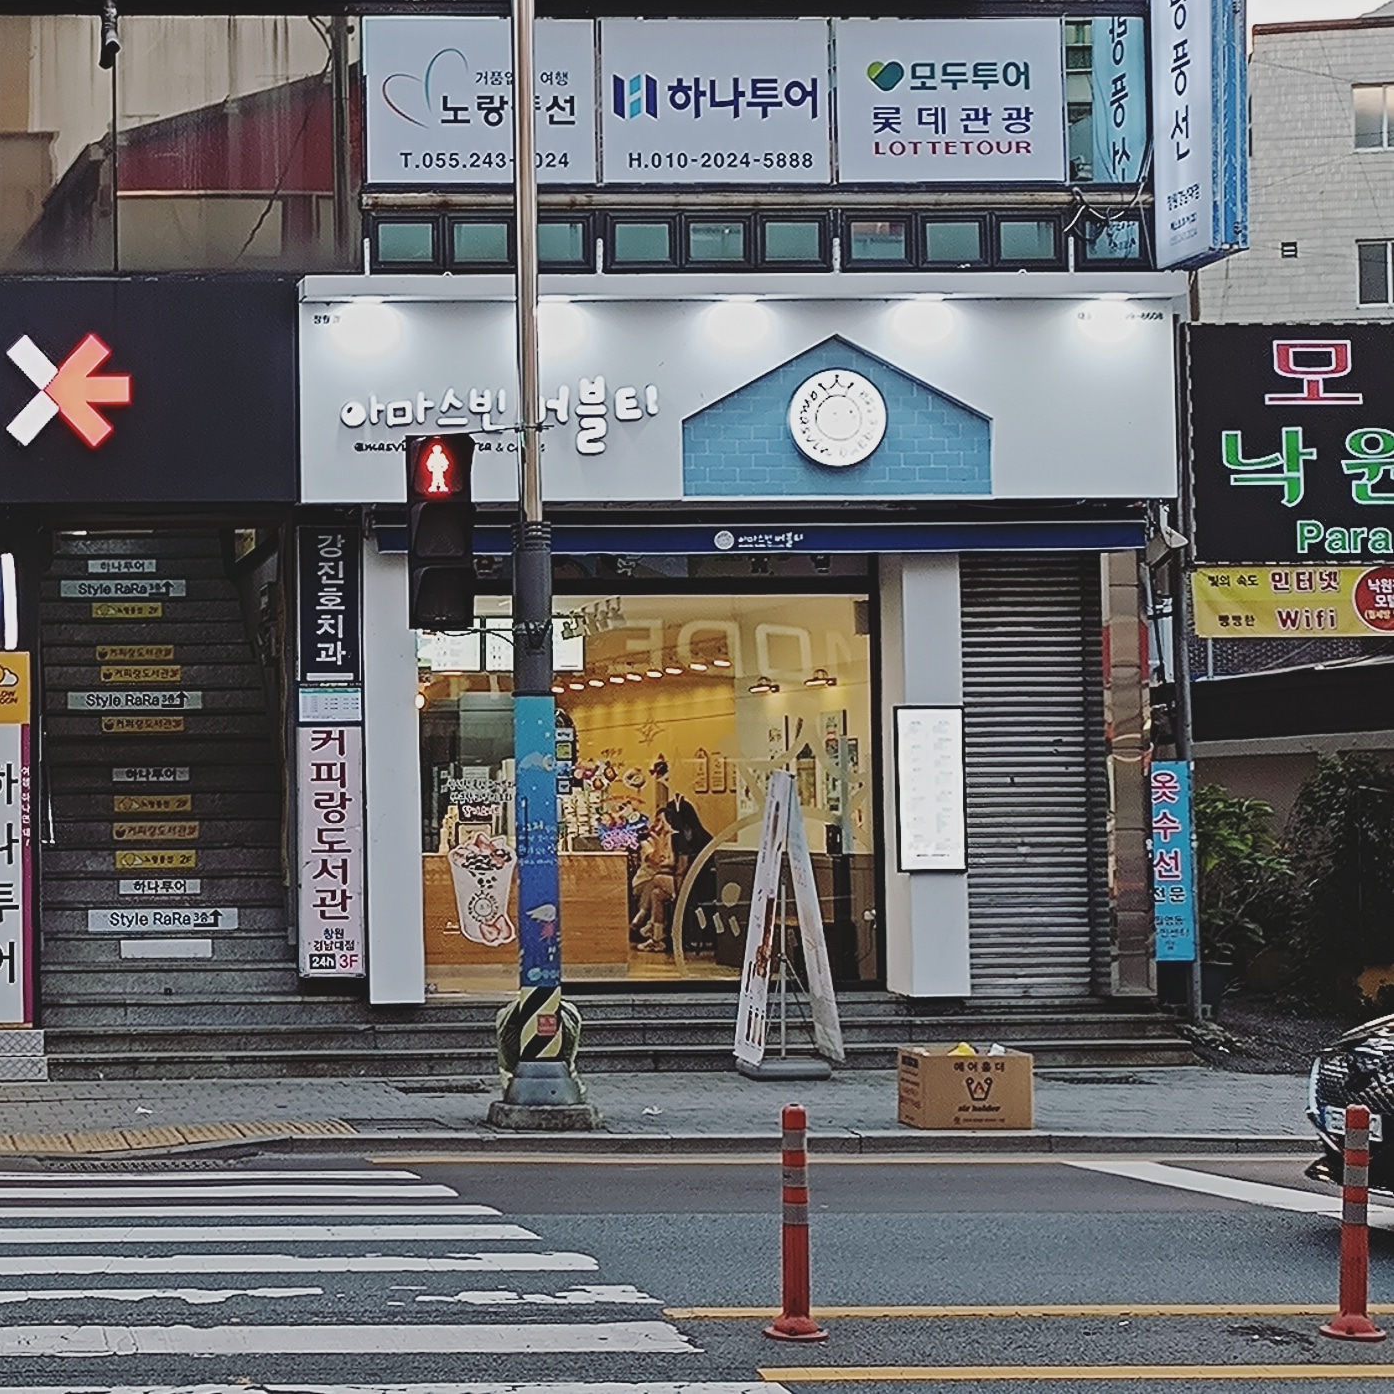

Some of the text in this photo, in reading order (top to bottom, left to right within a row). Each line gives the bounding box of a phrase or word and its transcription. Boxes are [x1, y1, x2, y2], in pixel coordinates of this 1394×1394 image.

[540, 70, 569, 86] 여행
[910, 61, 1031, 92] 모두투어
[667, 76, 818, 120] 하나투어
[440, 95, 576, 127] 노랑선
[872, 106, 1035, 135] 롯데관광
[873, 141, 1032, 157] LOTTETOUR
[400, 152, 570, 169] T.055.243-024
[628, 152, 814, 170] H.010-2024-5888
[1265, 339, 1363, 405] 모
[340, 375, 659, 455] 아마스빈 버블티
[355, 440, 407, 453] amasvi
[1222, 426, 1394, 507] 낙원
[1297, 520, 1394, 554] Para
[78, 583, 112, 596] Style
[115, 583, 148, 595] RaRa
[1271, 571, 1338, 591] 인터넷
[1367, 578, 1394, 593] 낙원
[316, 534, 346, 665] 강진호치과
[1277, 609, 1336, 628] Wifi
[86, 693, 122, 709] Style
[125, 694, 160, 706] RaRa
[126, 768, 177, 781] 하나투어
[309, 729, 353, 921] 커피랑도서관
[1151, 771, 1182, 881] 옷수선
[133, 880, 187, 894] 하나투어
[1154, 886, 1186, 903] 전문
[110, 912, 149, 928] Style
[153, 913, 191, 926] RaRa
[324, 927, 345, 940] 창원
[313, 940, 355, 952] 경남대점
[311, 953, 359, 969] 24h 3F
[953, 1061, 1005, 1073] 에어홀더
